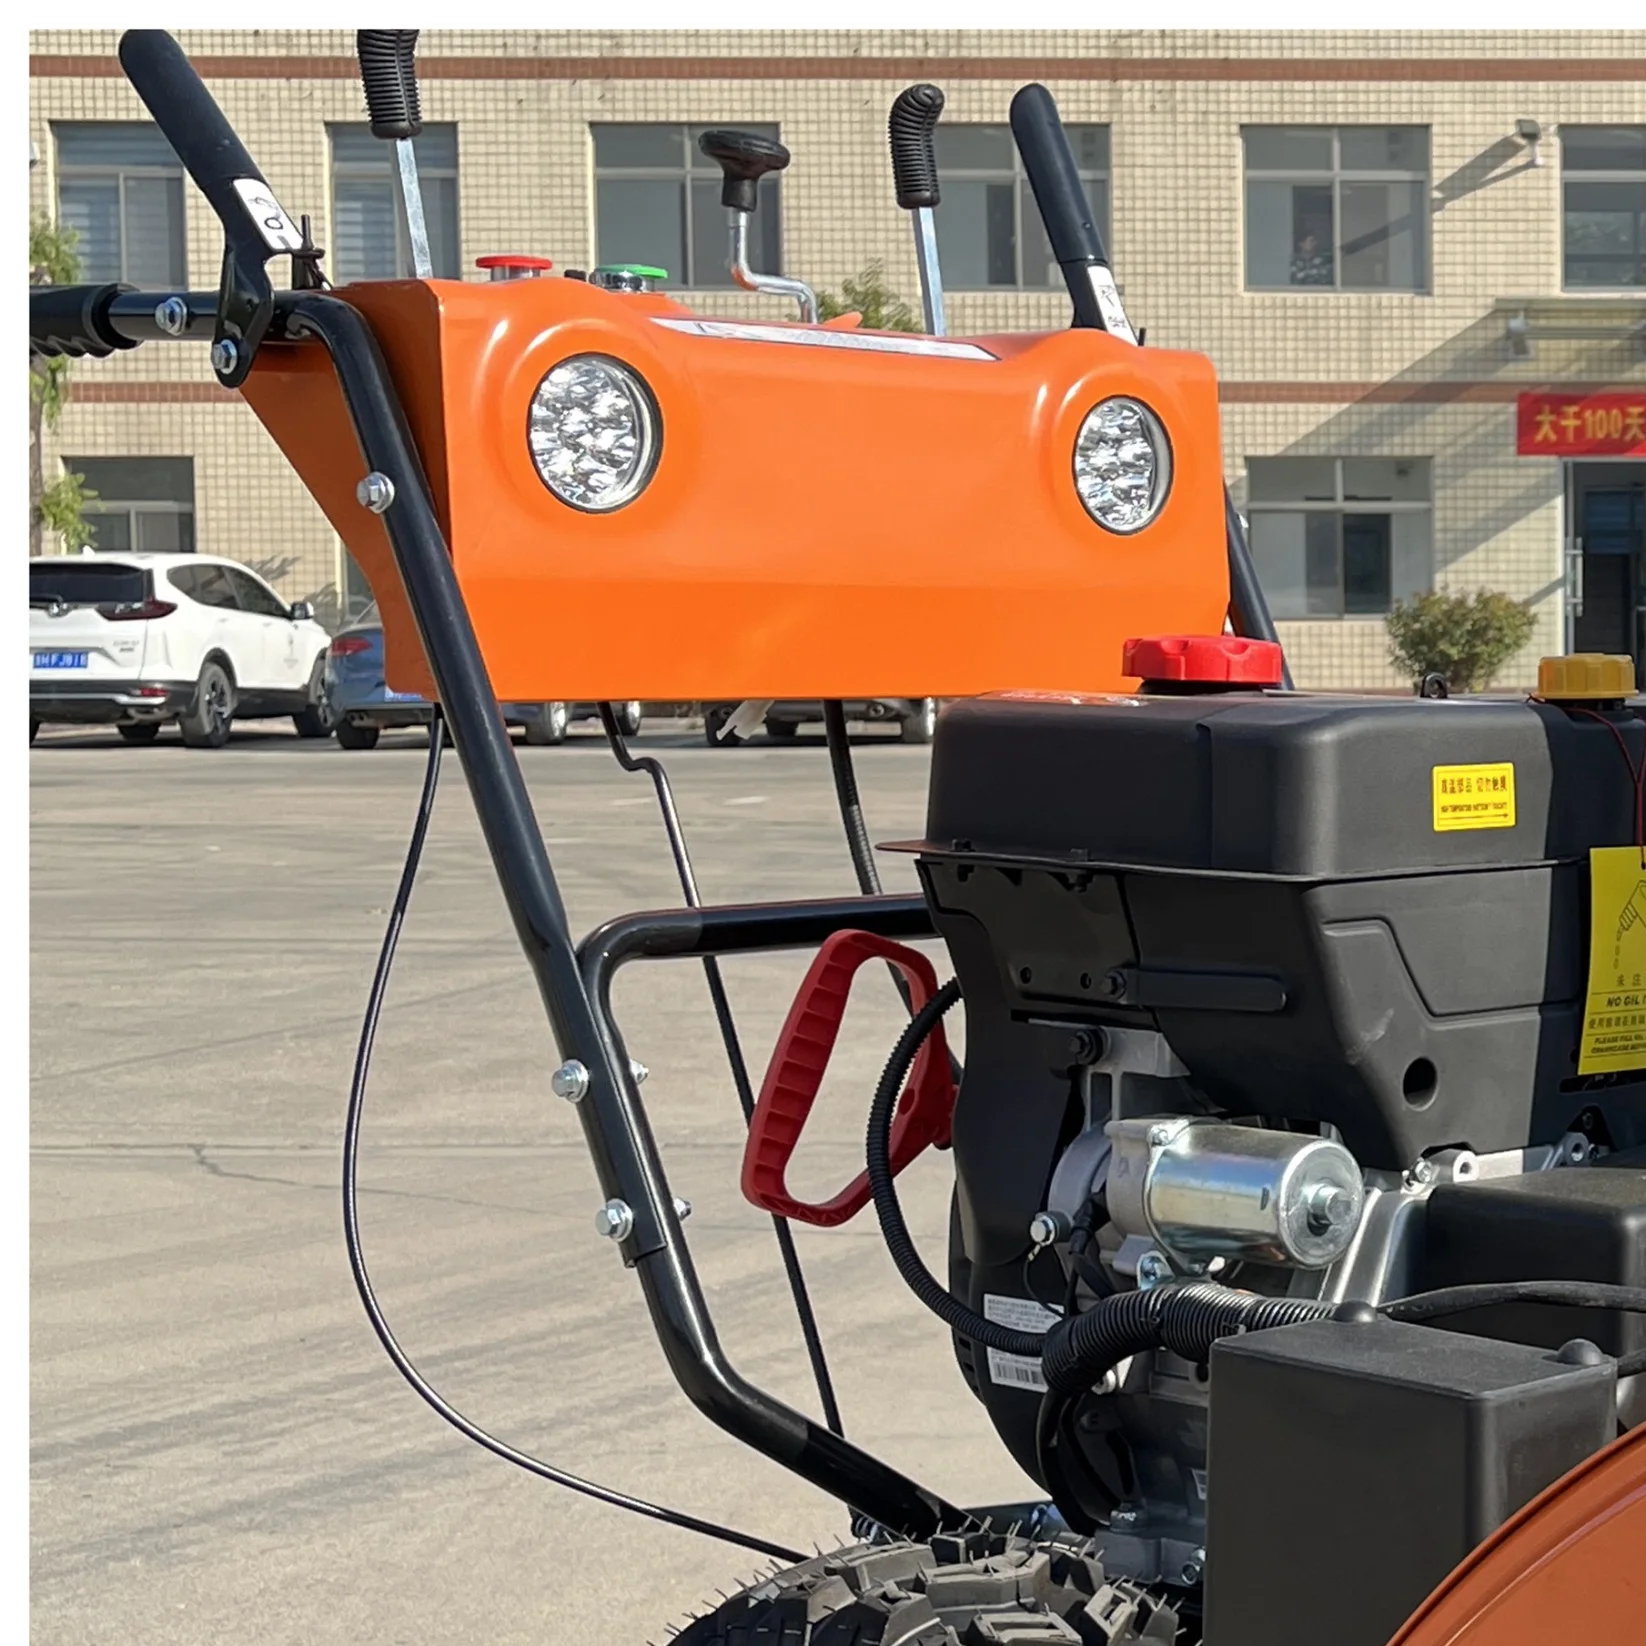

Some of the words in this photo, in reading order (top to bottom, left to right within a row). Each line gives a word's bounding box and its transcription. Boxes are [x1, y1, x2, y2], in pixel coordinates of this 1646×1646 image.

[1534, 405, 1646, 443] 大干100天
[1606, 996, 1623, 1008] NO
[1623, 994, 1640, 1007] OIL
